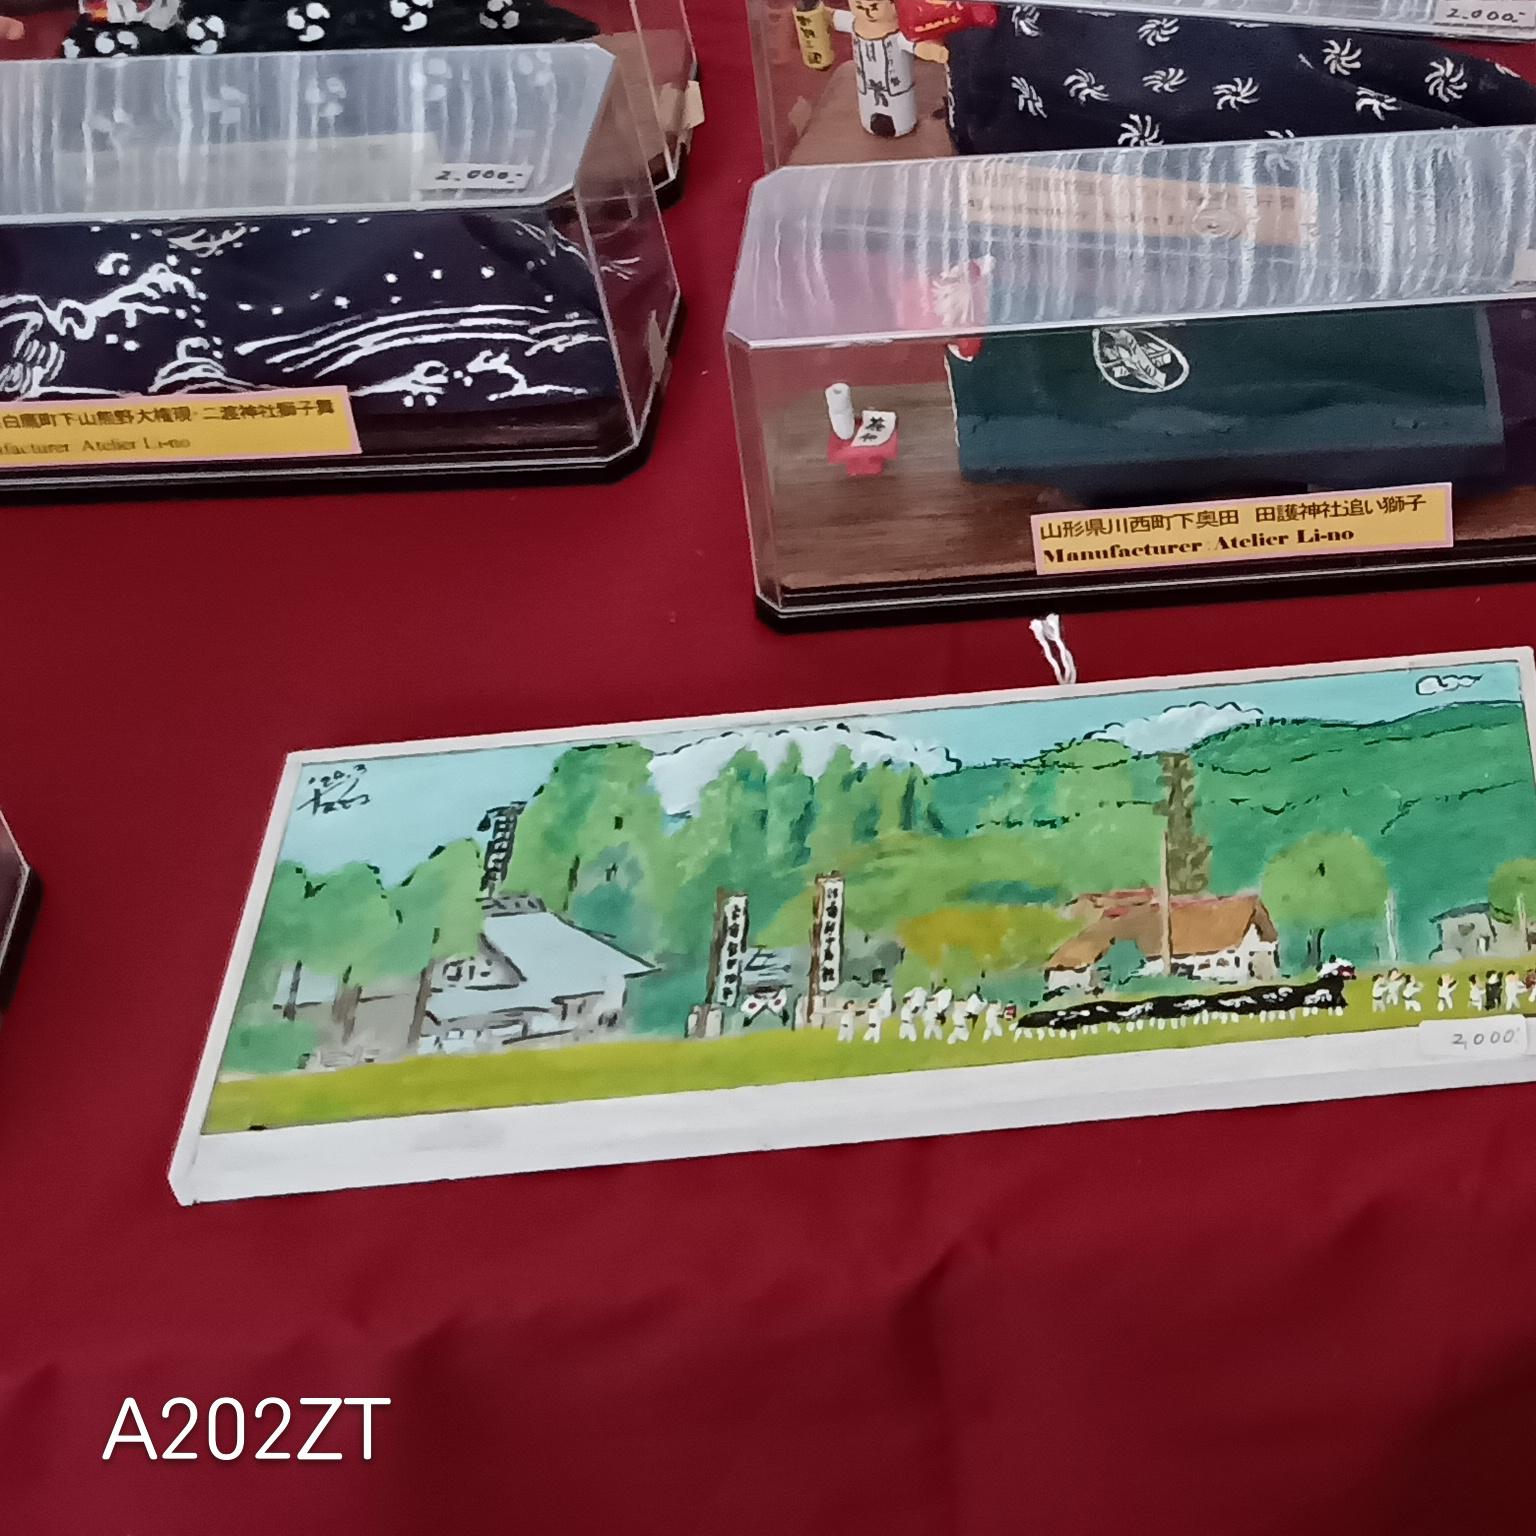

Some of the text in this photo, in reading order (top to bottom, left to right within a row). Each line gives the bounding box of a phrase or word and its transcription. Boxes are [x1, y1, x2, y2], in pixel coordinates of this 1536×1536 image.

[1039, 493, 1427, 541] 山形県川西町下奥田 田護神社追い獅子
[1043, 526, 1355, 565] Manufacturer Atelier Li-no
